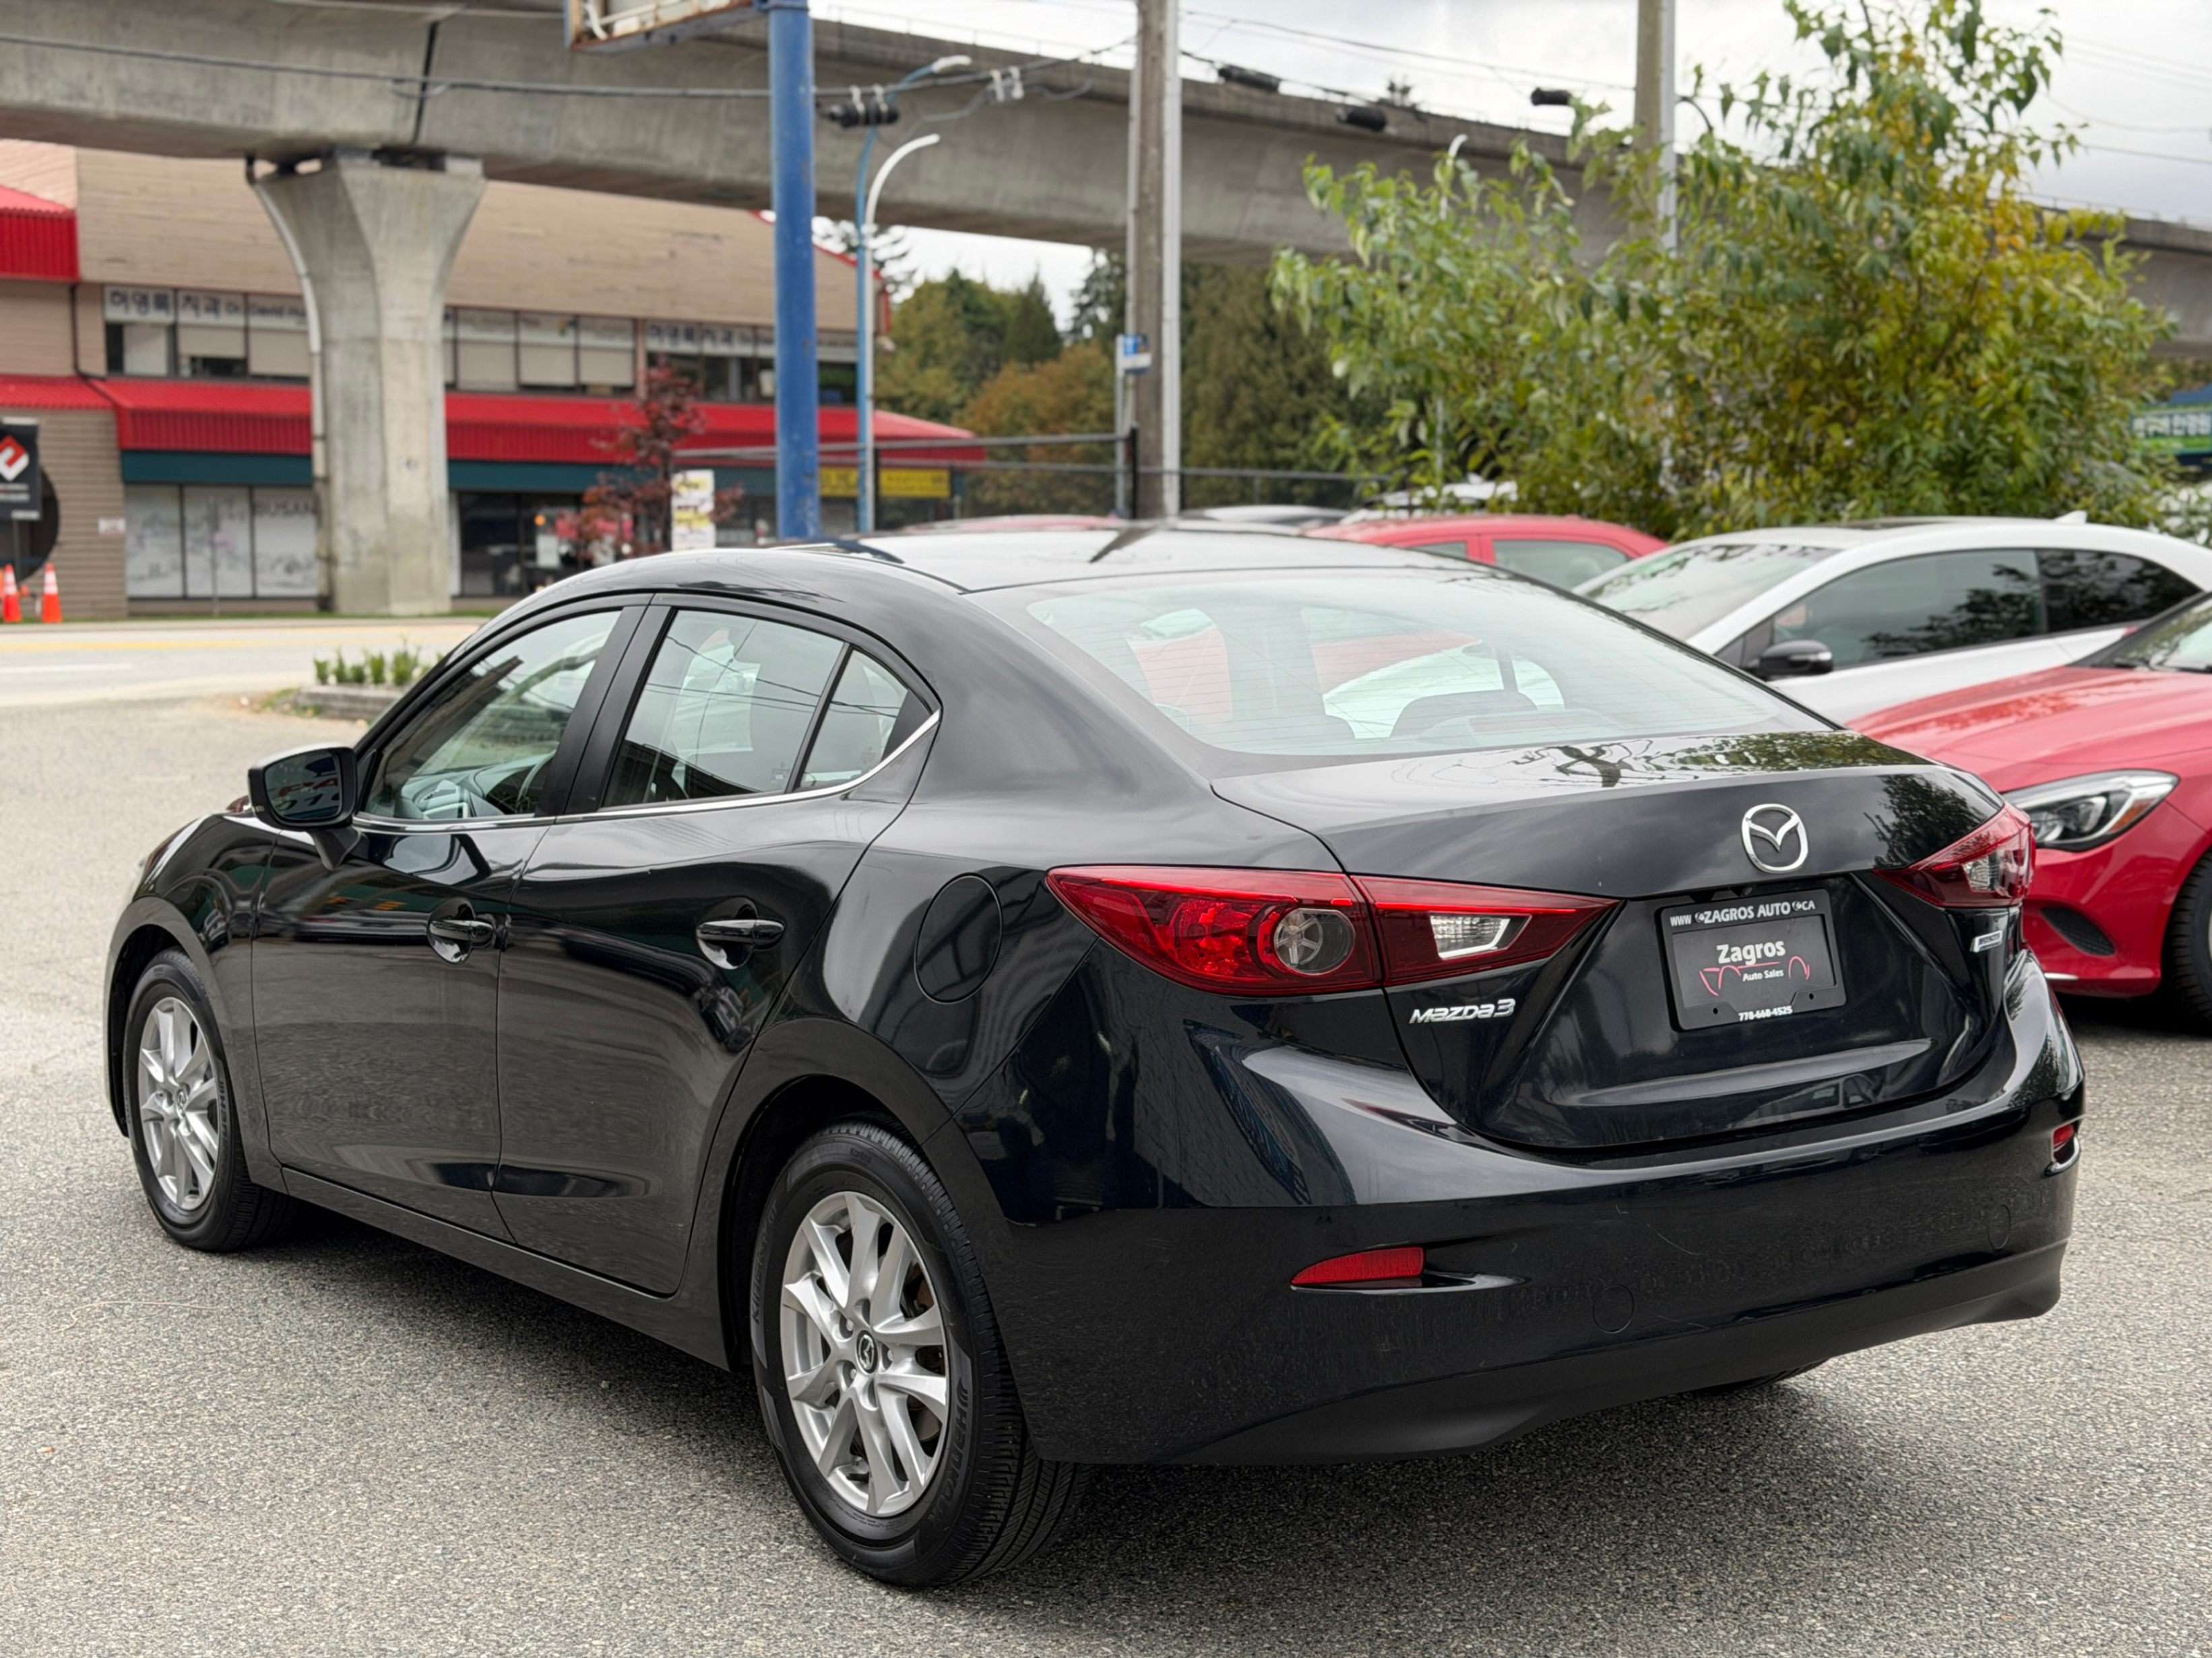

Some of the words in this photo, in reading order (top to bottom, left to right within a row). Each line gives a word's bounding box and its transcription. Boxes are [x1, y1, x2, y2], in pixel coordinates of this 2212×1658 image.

[1704, 906, 1755, 924] ZAGROS
[1757, 901, 1791, 918] AUTO
[1716, 940, 1786, 965] Zagros
[1742, 972, 1763, 982] Auto
[1765, 969, 1784, 980] Sales
